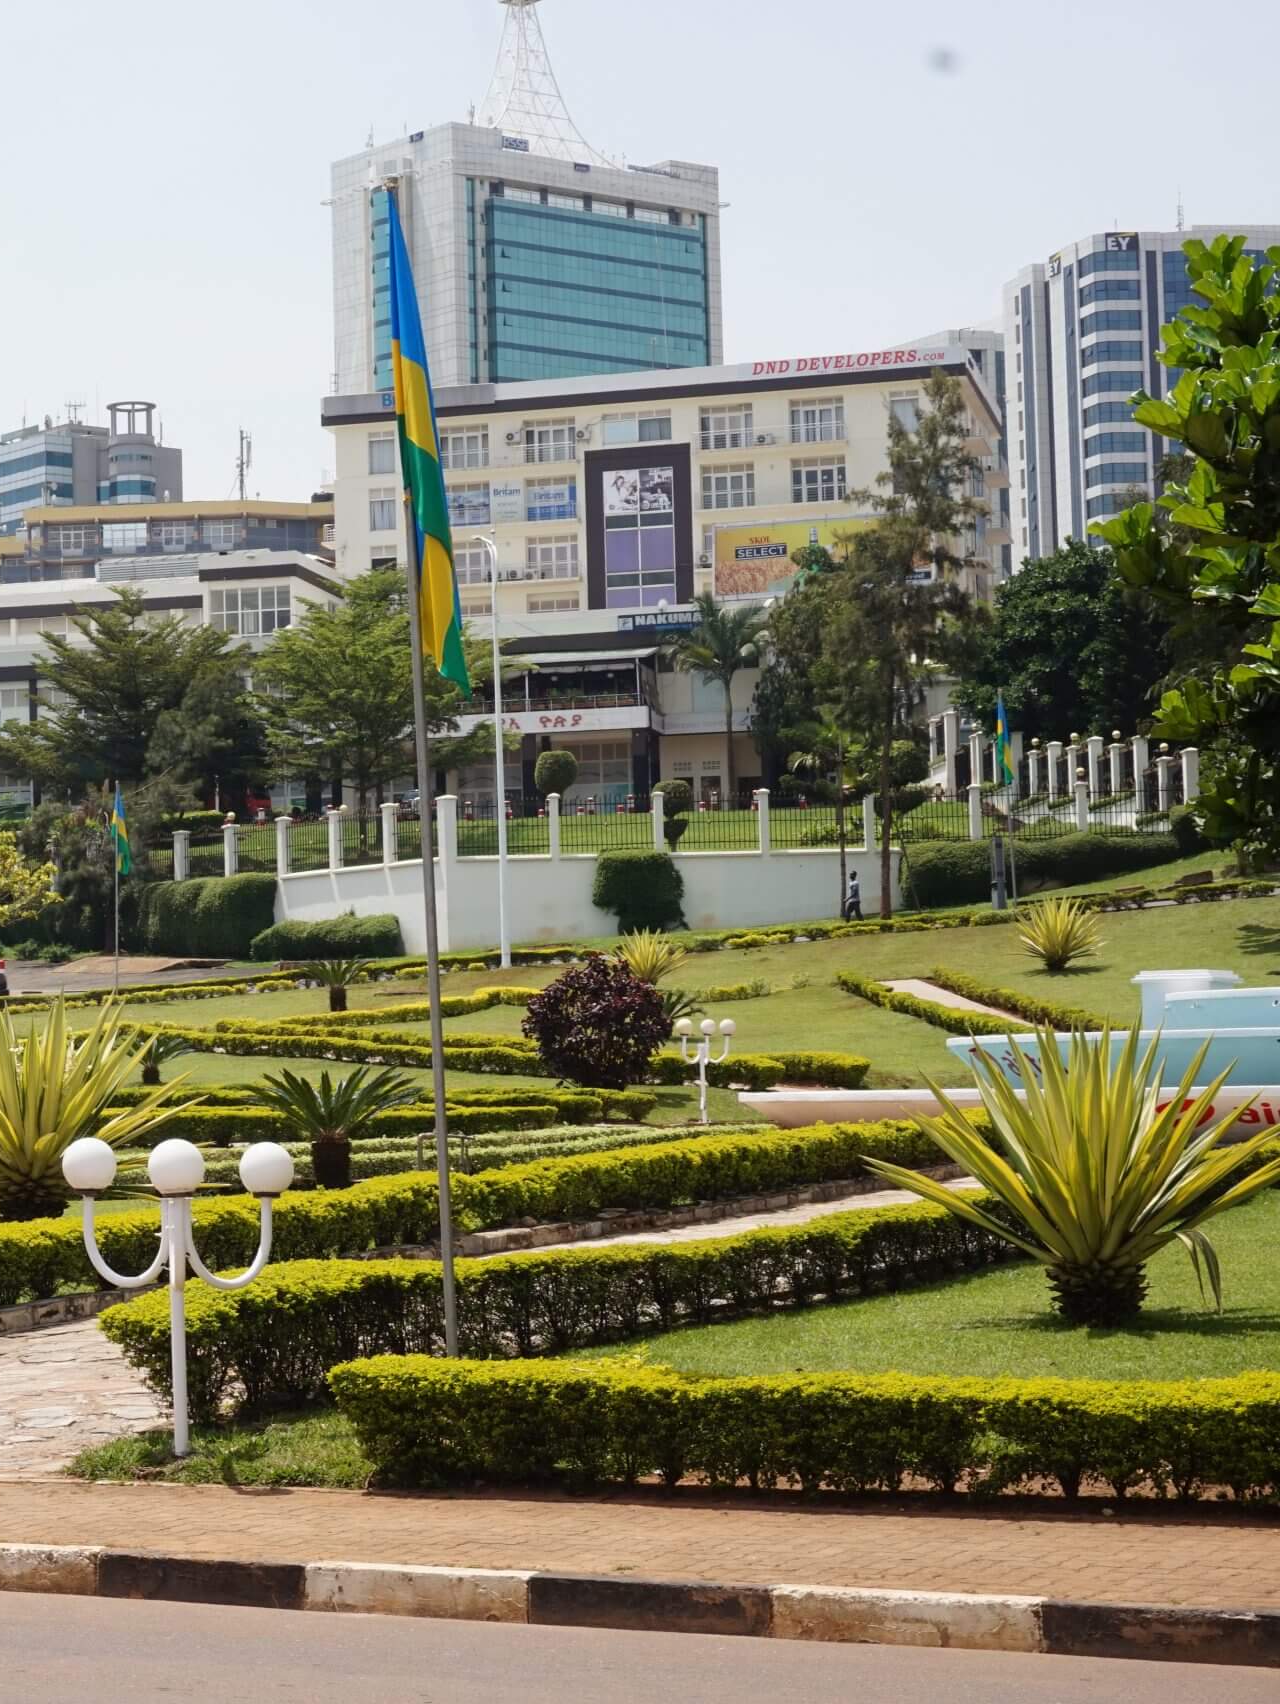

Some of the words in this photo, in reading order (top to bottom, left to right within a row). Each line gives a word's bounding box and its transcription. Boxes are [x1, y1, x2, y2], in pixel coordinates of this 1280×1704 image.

[1106, 237, 1130, 251] EY
[752, 360, 790, 376] DND
[493, 487, 521, 497] Britam
[749, 536, 770, 545] SKOL
[737, 546, 785, 558] SELECT
[1233, 1102, 1280, 1125] ai
